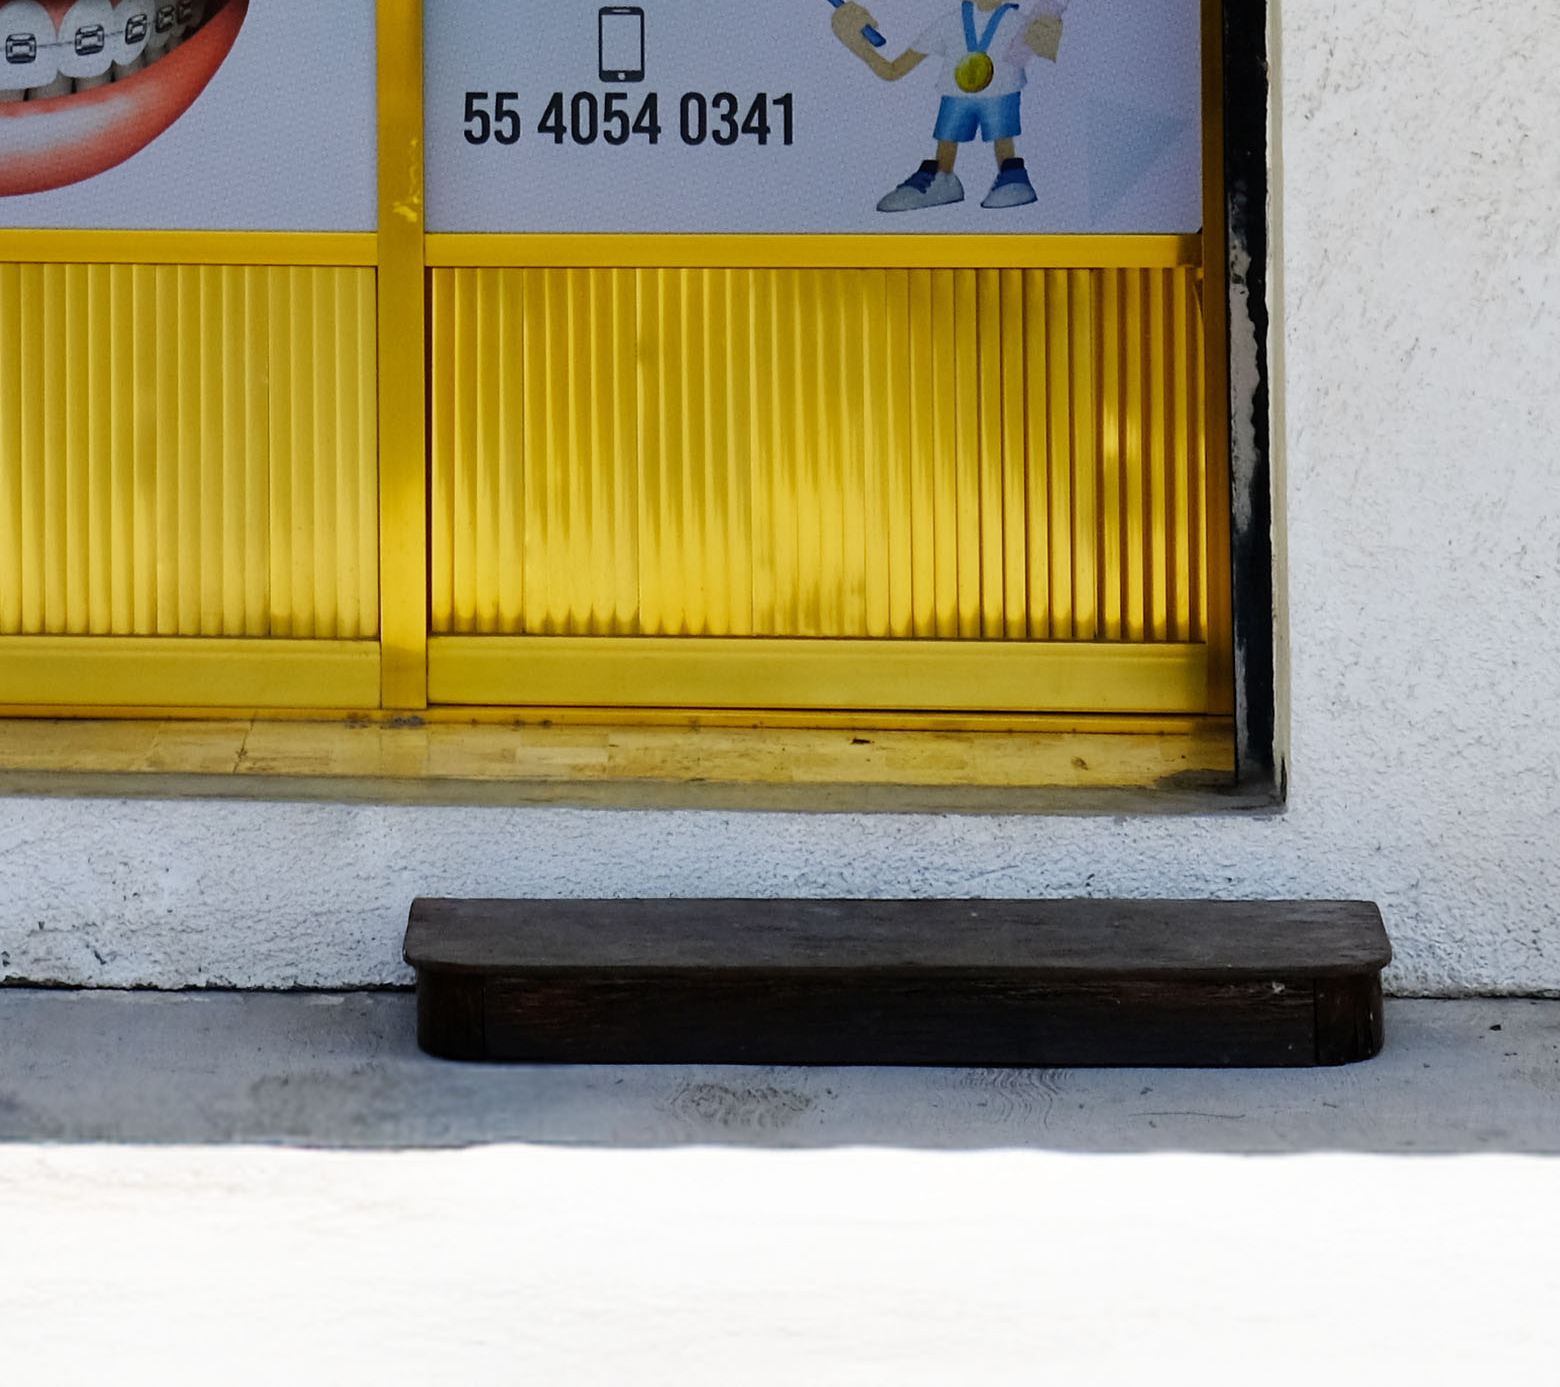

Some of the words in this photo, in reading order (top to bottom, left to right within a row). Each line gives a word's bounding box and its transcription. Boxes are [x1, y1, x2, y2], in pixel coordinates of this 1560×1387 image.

[463, 91, 521, 146] 55
[537, 90, 662, 146] 4054
[679, 91, 794, 146] 0341
